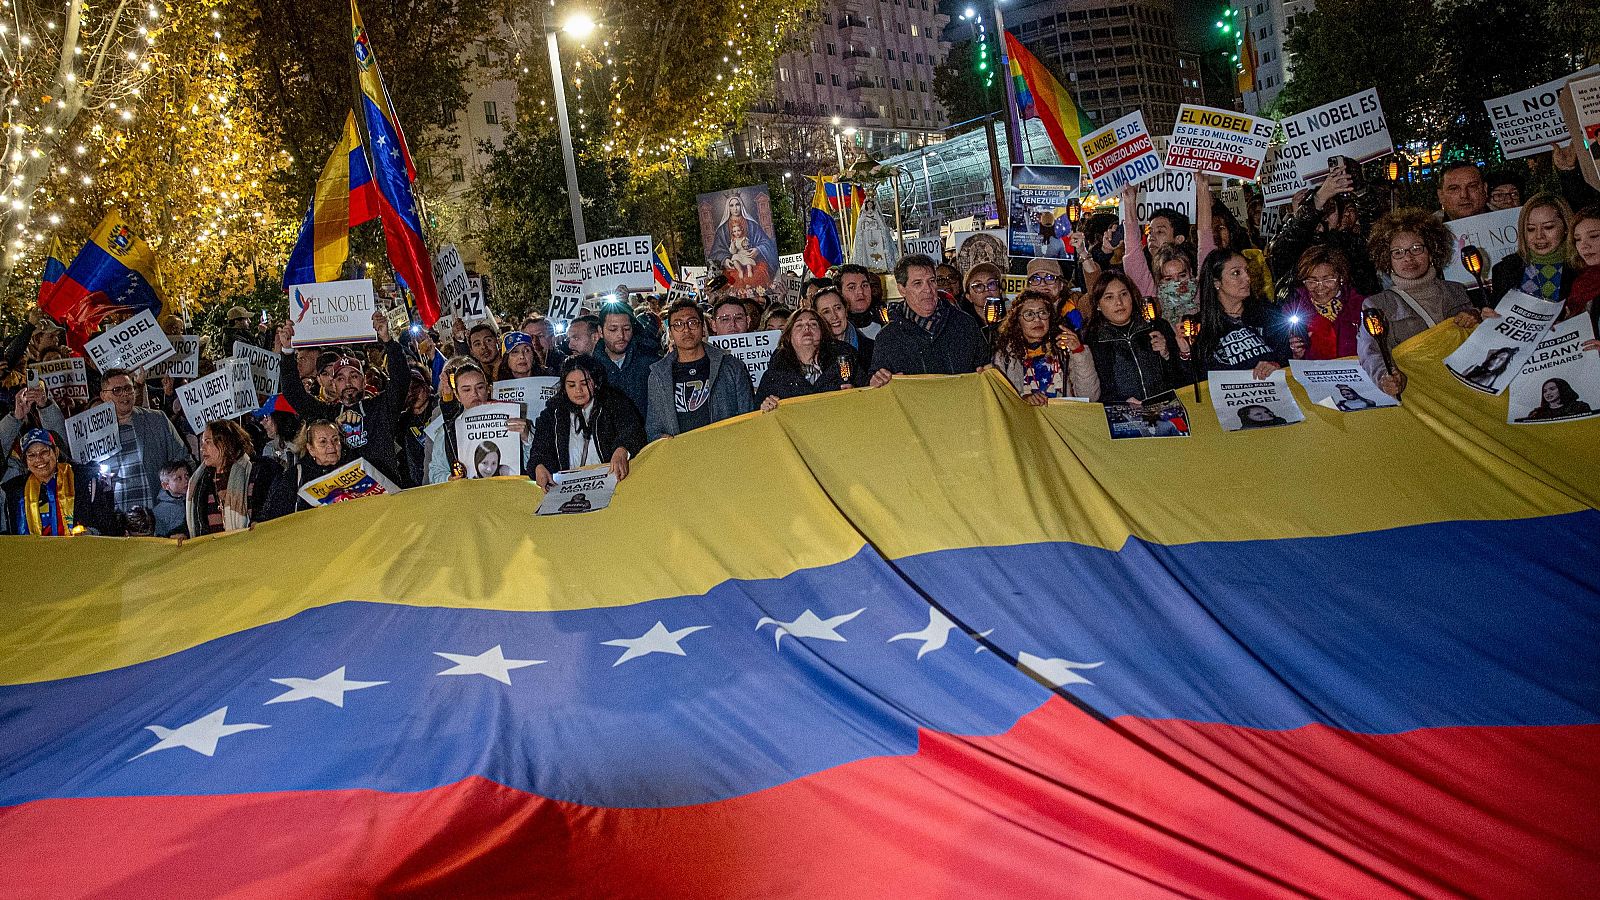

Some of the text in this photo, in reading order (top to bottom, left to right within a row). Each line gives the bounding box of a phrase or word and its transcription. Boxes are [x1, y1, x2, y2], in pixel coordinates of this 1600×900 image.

[1491, 88, 1564, 120] EL NO
[1180, 110, 1273, 138] EL NOBEL ES
[1285, 94, 1378, 140] EL NOBEL ES
[1497, 108, 1556, 130] RECONOCE
[1500, 116, 1566, 138] NUESTRA LU
[1503, 125, 1569, 147] POR LA LIBE
[1084, 121, 1141, 158] EL NOBEL ES DE
[1174, 136, 1244, 154] VENEZOLANOS
[1176, 126, 1186, 134] ES
[1200, 129, 1210, 137] 30
[1212, 130, 1254, 146] MILLONES
[1254, 140, 1268, 150] DE
[1291, 116, 1387, 160] DE VENEZUELA
[1089, 160, 1104, 174] LOS
[1103, 137, 1150, 168] VENEZOLANOS
[1168, 156, 1175, 165] Y
[1176, 157, 1222, 171] LIBERTAD
[1170, 146, 1258, 168] QUE QUIEREN PAZ
[1095, 178, 1113, 198] EN
[1112, 154, 1160, 188] MADRID
[1138, 172, 1192, 193] ADURO?
[1262, 170, 1297, 185] CAMINO
[1020, 197, 1068, 205] VENEZUELA!
[1221, 191, 1239, 203] ERTAD
[1136, 202, 1190, 222] ODRIDO!
[1261, 212, 1278, 235] PAZ
[1488, 225, 1518, 247] NO
[580, 240, 649, 262] EL NOBEL ES
[904, 240, 940, 254] ADURO?
[433, 248, 460, 282] ADURO?
[554, 263, 564, 276] PAZ
[567, 262, 581, 274] LIBER
[582, 260, 653, 280] DE VENEZUELA
[439, 272, 468, 308] ODRIDO!
[556, 284, 581, 294] JUSTA
[672, 282, 692, 292] JUSTA
[1001, 278, 1026, 293] OBE
[312, 294, 370, 315] EL NOBEL
[549, 296, 580, 320] PAZ
[1512, 304, 1540, 320] LIBERTAD
[312, 314, 349, 326] ES NUESTRO
[1505, 316, 1546, 332] GENESIS
[90, 318, 155, 360] EL NOBEL
[1494, 322, 1538, 343] RIERA
[1556, 332, 1578, 344] PARA
[133, 340, 156, 358] LUCHA
[174, 340, 198, 354] URO?
[712, 335, 770, 350] NOBEL ES
[1230, 336, 1265, 355] CARL
[97, 342, 134, 366] RECOCE
[130, 344, 162, 368] LIBERTAD
[732, 348, 772, 361] UE ESTÁN
[1522, 352, 1584, 374] COLMENARES
[40, 360, 84, 374] NOBEL ES
[44, 373, 86, 386] TODA LA
[254, 374, 276, 394] RIDO!
[48, 386, 86, 398] ASPORA
[184, 388, 199, 406] PAZ
[198, 388, 204, 406] y
[498, 391, 524, 399] ROCÍO
[1224, 388, 1277, 400] ALAYNE
[1226, 396, 1280, 406] RANGEL
[72, 420, 84, 440] PAZ
[87, 408, 114, 433] LIBERTAD
[194, 415, 204, 428] en
[465, 414, 492, 423] LIBERTAD
[468, 430, 509, 440] GUEDEZ
[84, 432, 118, 460] VENEZUELA
[561, 480, 605, 491] MARÍA
